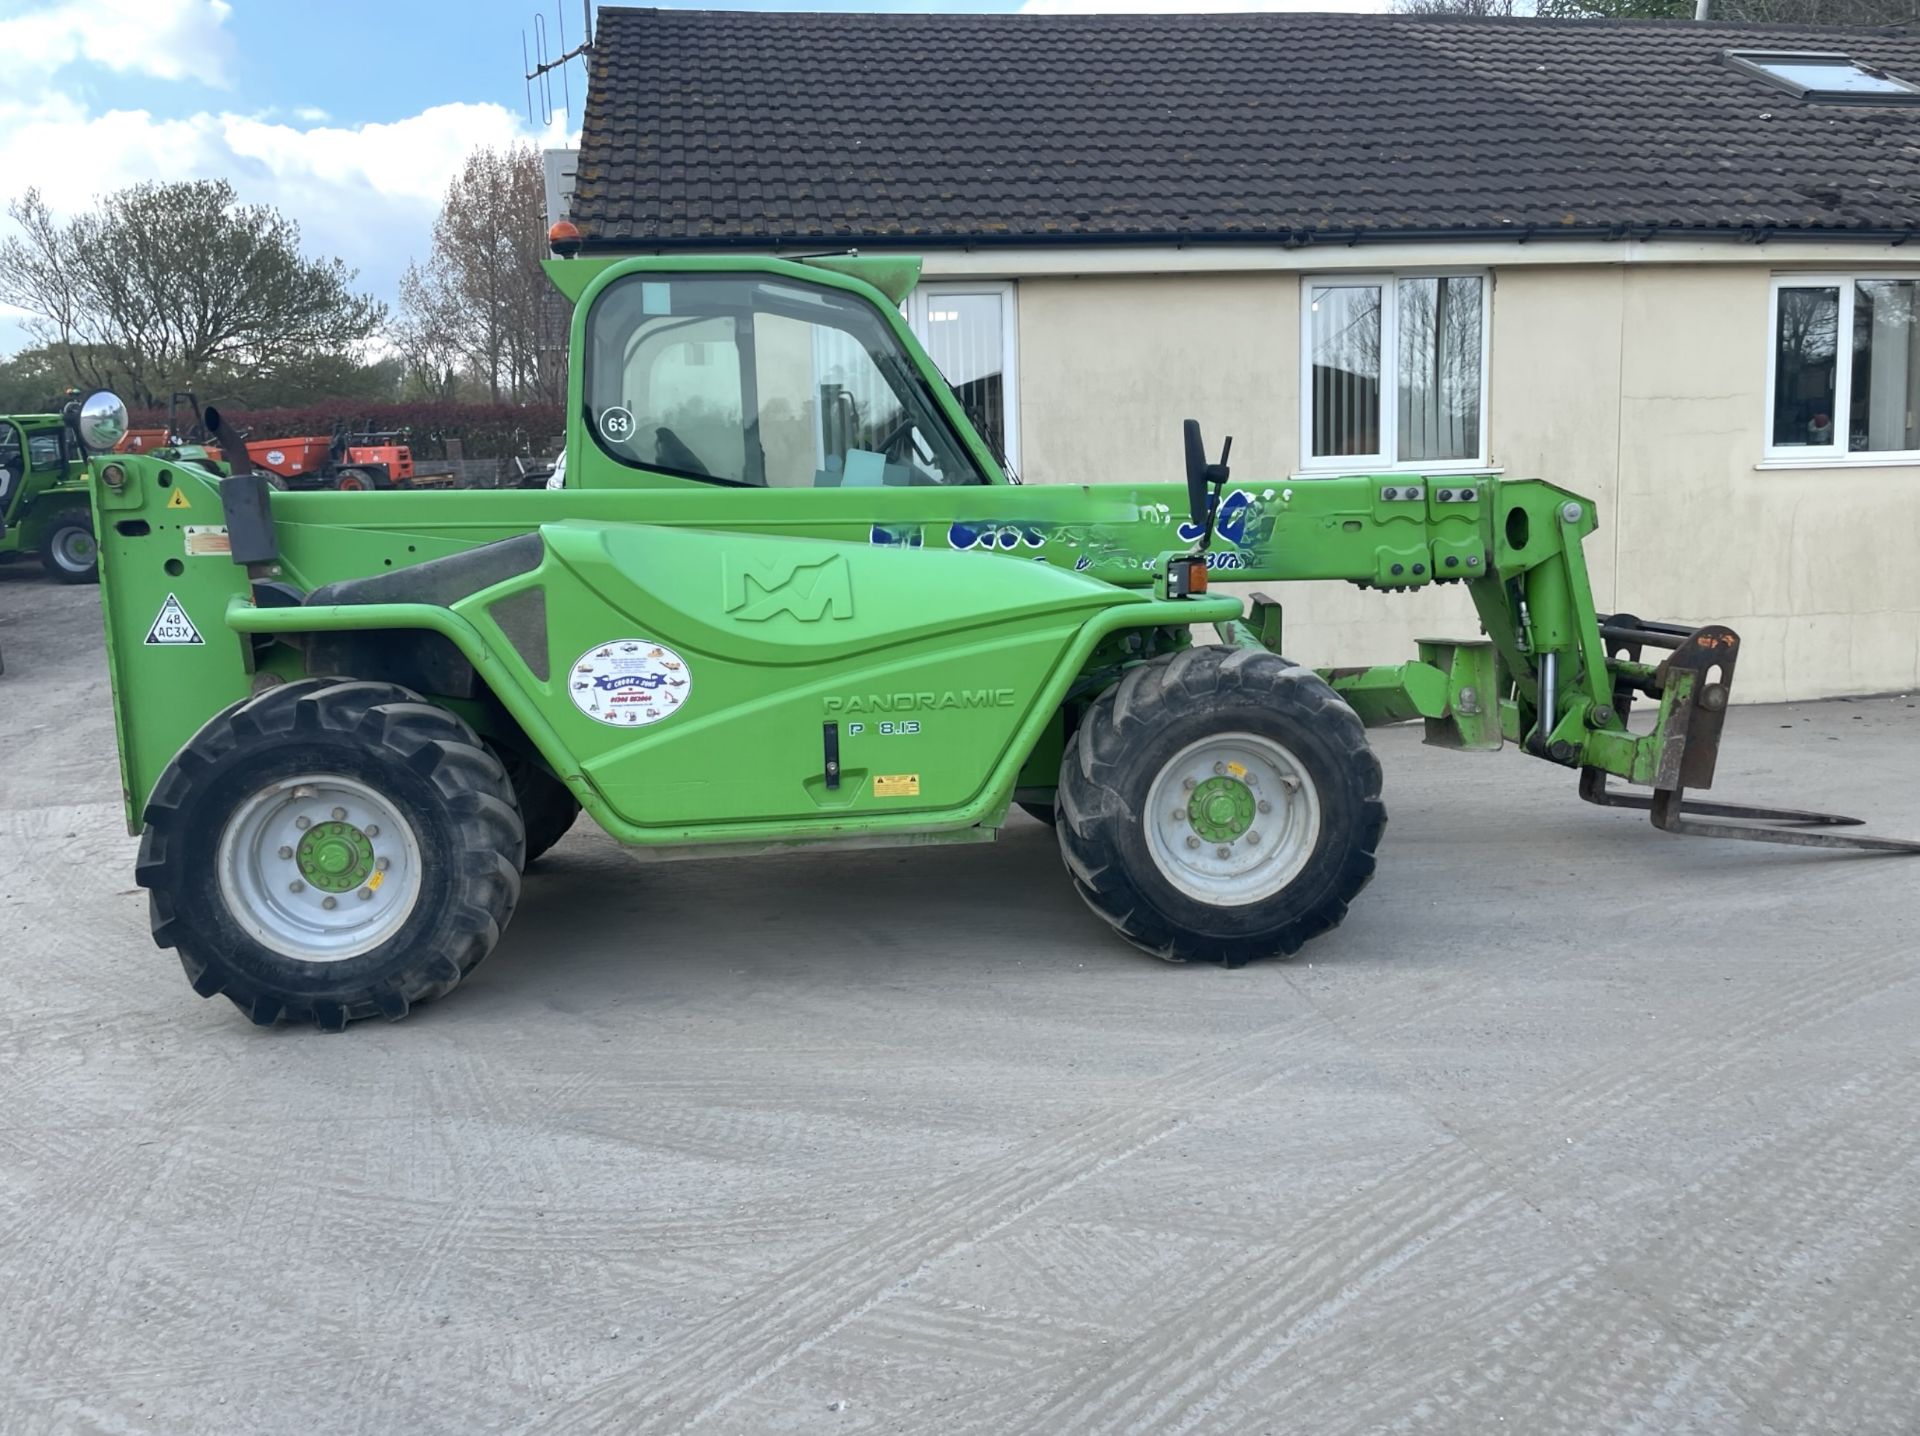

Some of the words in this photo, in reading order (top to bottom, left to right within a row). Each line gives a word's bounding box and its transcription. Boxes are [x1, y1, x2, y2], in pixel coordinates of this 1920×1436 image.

[608, 417, 628, 432] 63
[166, 614, 181, 625] 48
[158, 626, 189, 638] AC3X
[823, 688, 1015, 715] PANORAMIC
[849, 723, 864, 736] P
[880, 721, 920, 735] 8.13
